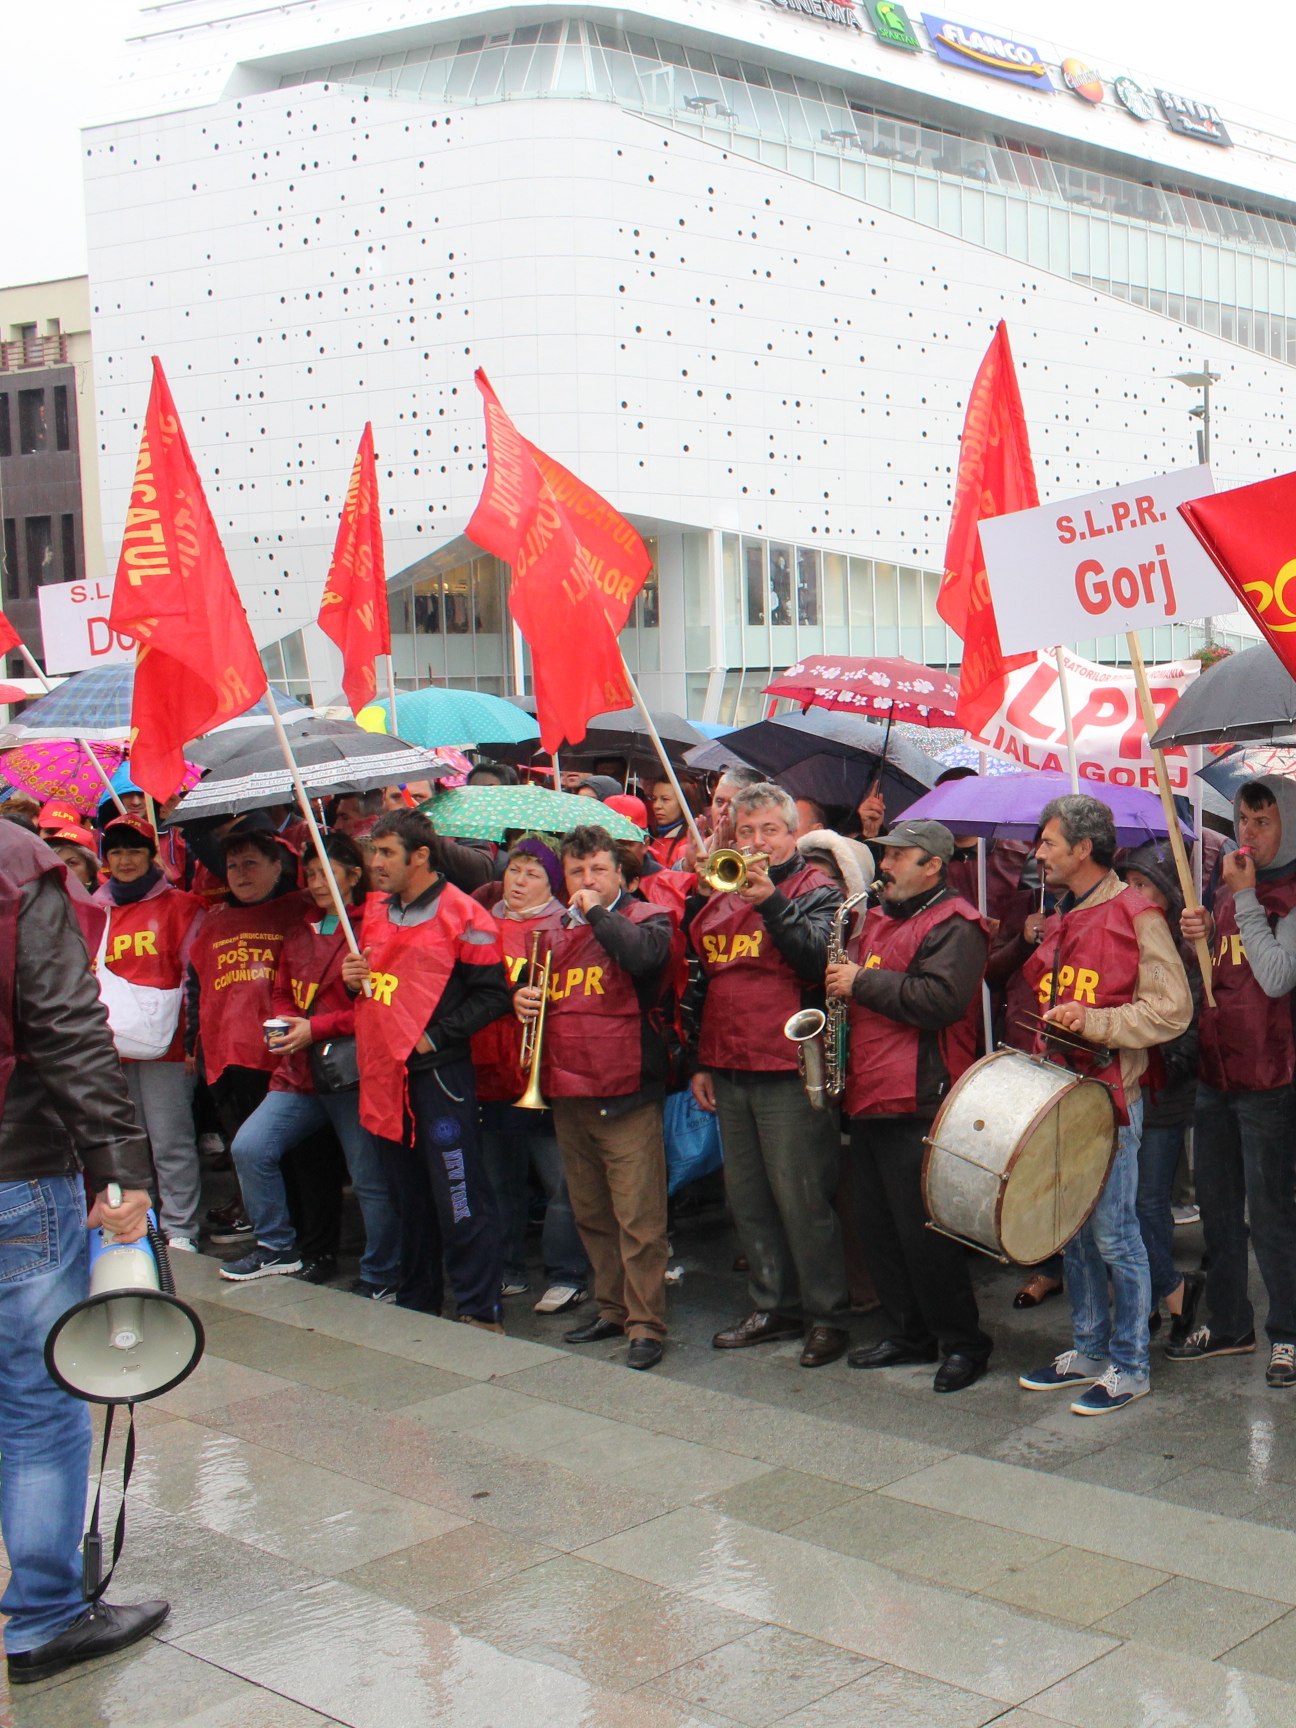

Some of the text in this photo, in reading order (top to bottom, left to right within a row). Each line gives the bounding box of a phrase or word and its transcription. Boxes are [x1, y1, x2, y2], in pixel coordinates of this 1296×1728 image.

[879, 27, 919, 47] SPARTAN
[942, 23, 1035, 66] FLANCO
[1056, 496, 1167, 545] S.L.P.R.
[71, 582, 110, 603] S.L
[1075, 545, 1177, 617] Gorj
[87, 617, 137, 656] Do
[1043, 647, 1112, 683] LURATORILOR
[1006, 661, 1188, 760] LPR
[1078, 761, 1188, 789] GORJ
[52, 811, 74, 822] SLPR
[217, 947, 275, 970] POSTA
[702, 930, 763, 963] SLPR
[547, 965, 605, 1002] LPR
[442, 1149, 472, 1224] NEW YORK
